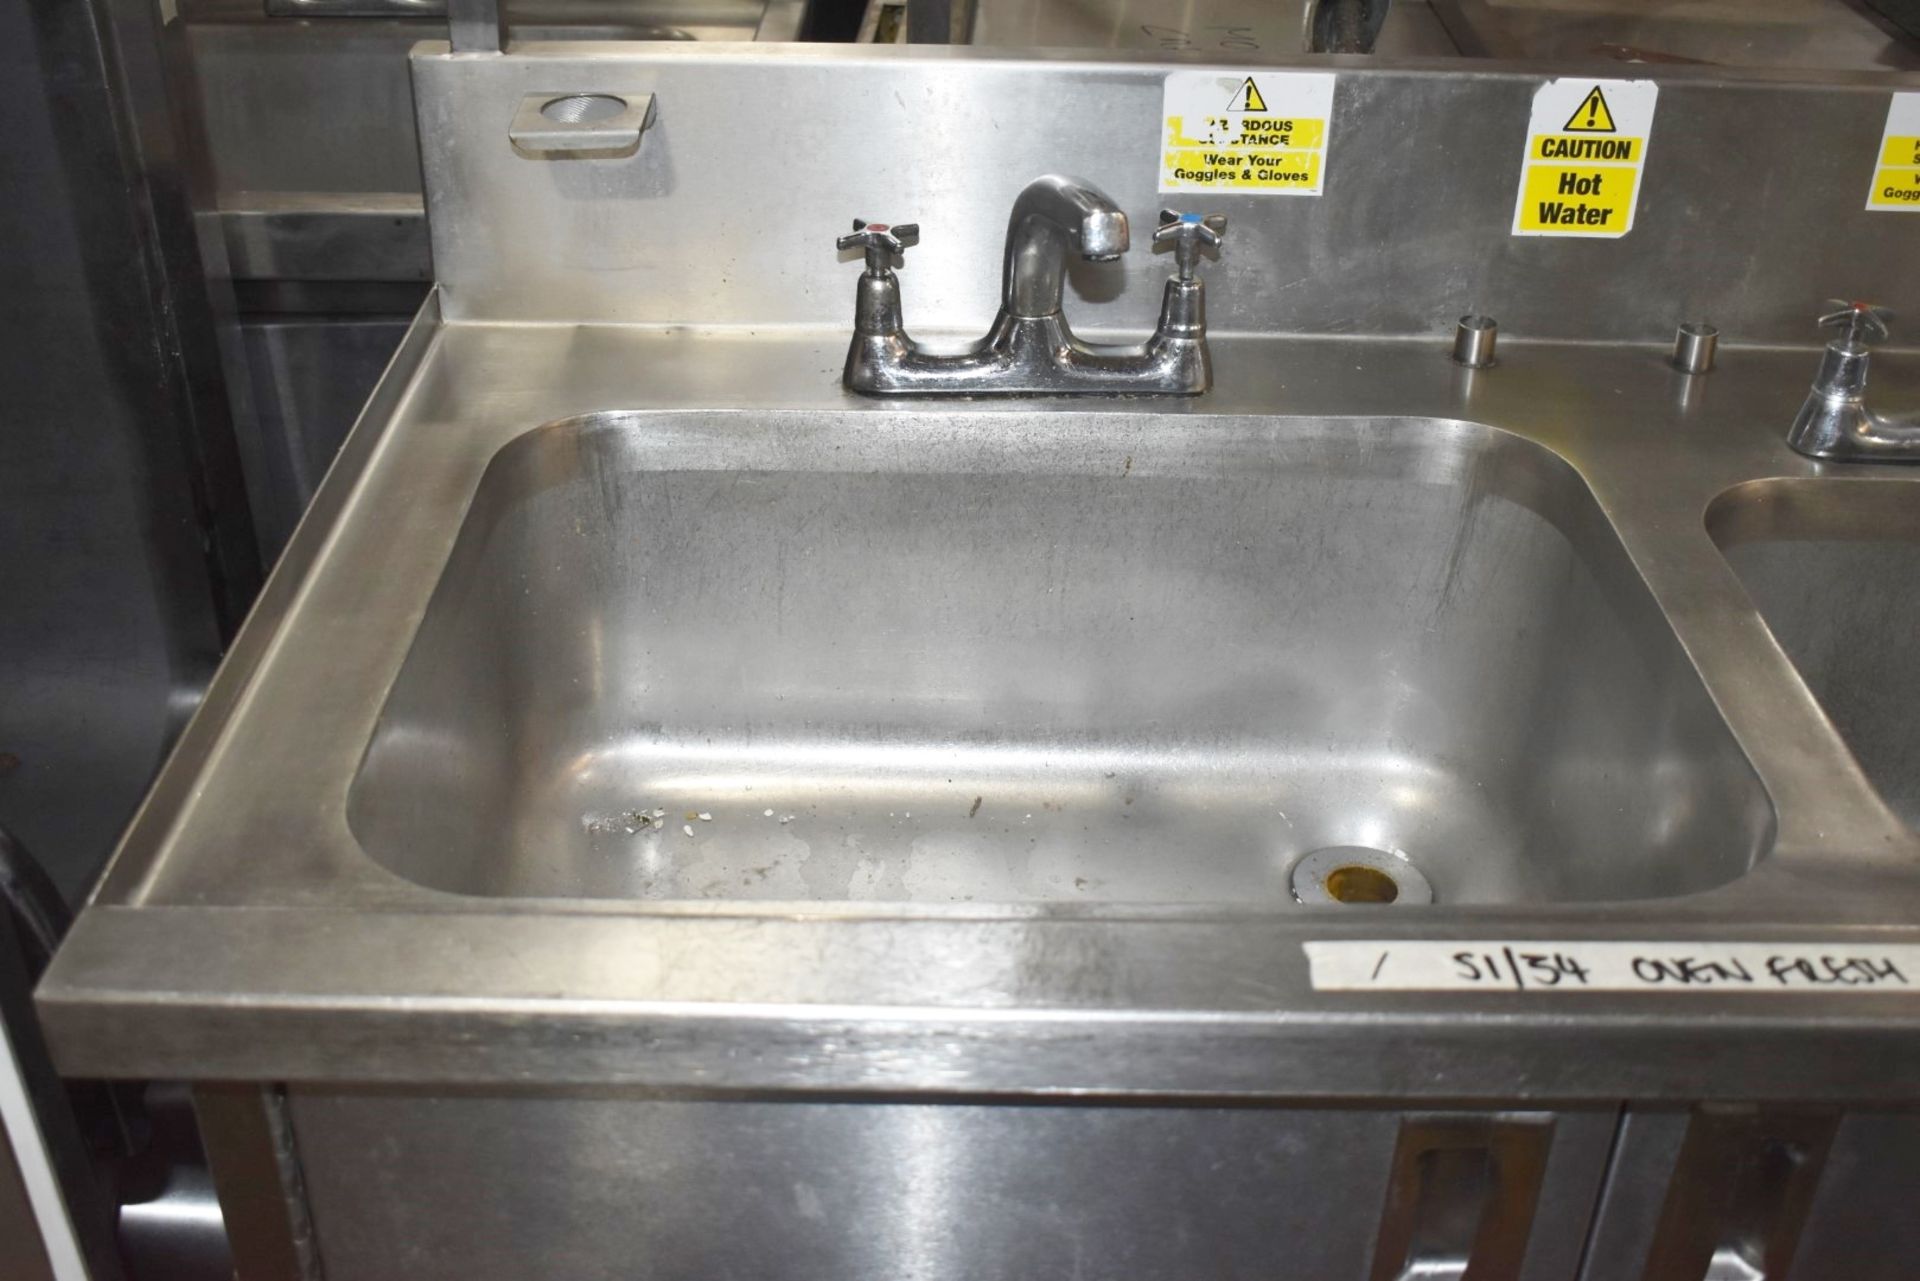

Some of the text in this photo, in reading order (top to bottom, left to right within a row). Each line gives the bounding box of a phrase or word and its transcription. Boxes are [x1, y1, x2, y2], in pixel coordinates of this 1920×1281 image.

[1198, 134, 1290, 145] TANCE
[1541, 138, 1632, 159] CAUTION
[1204, 154, 1283, 166] Wear Your
[1174, 168, 1309, 181] Goggles & Gloves
[1558, 172, 1602, 195] Hot
[1538, 202, 1613, 225] Water
